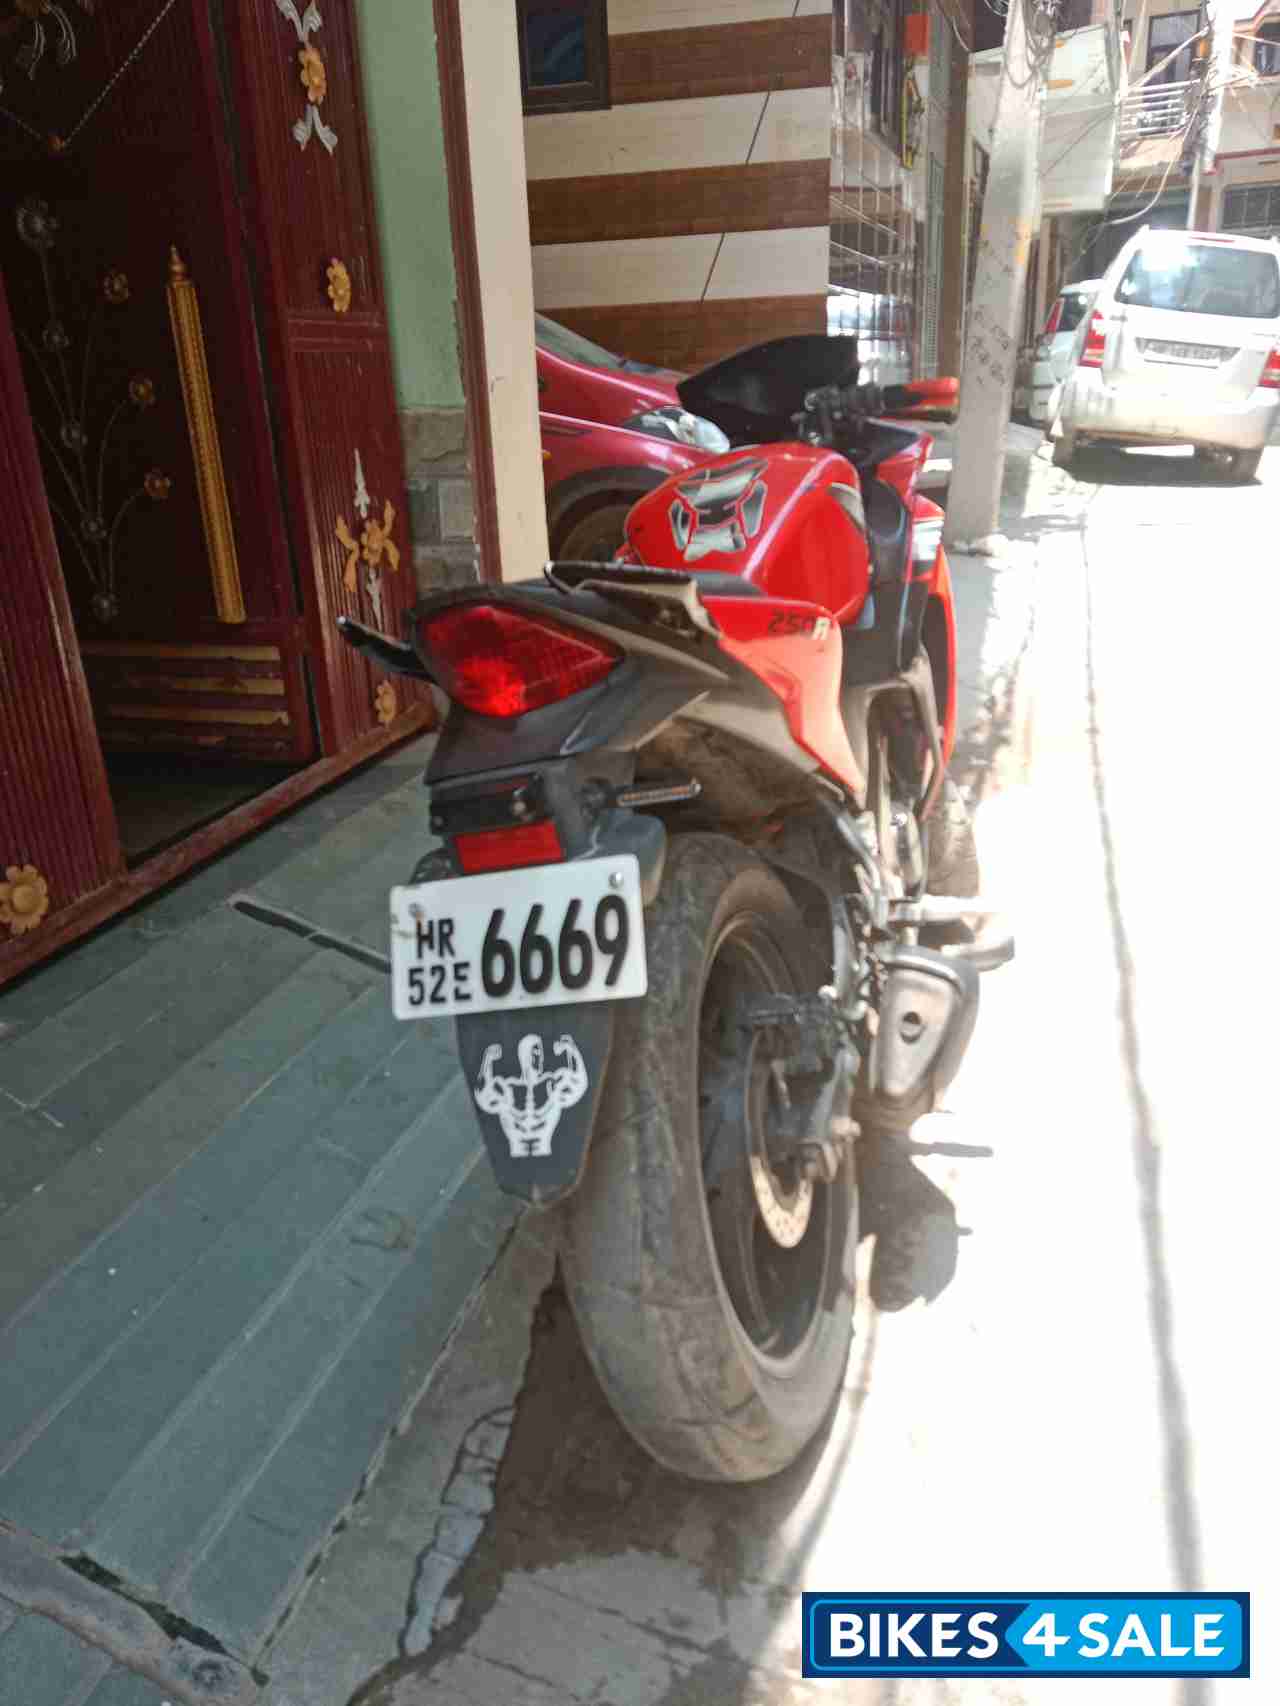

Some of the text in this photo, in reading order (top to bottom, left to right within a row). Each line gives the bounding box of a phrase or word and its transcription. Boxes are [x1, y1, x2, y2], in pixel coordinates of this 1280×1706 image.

[767, 608, 833, 640] 250R
[415, 917, 456, 960] HR
[480, 894, 630, 999] 6669
[408, 961, 472, 1006] 52E
